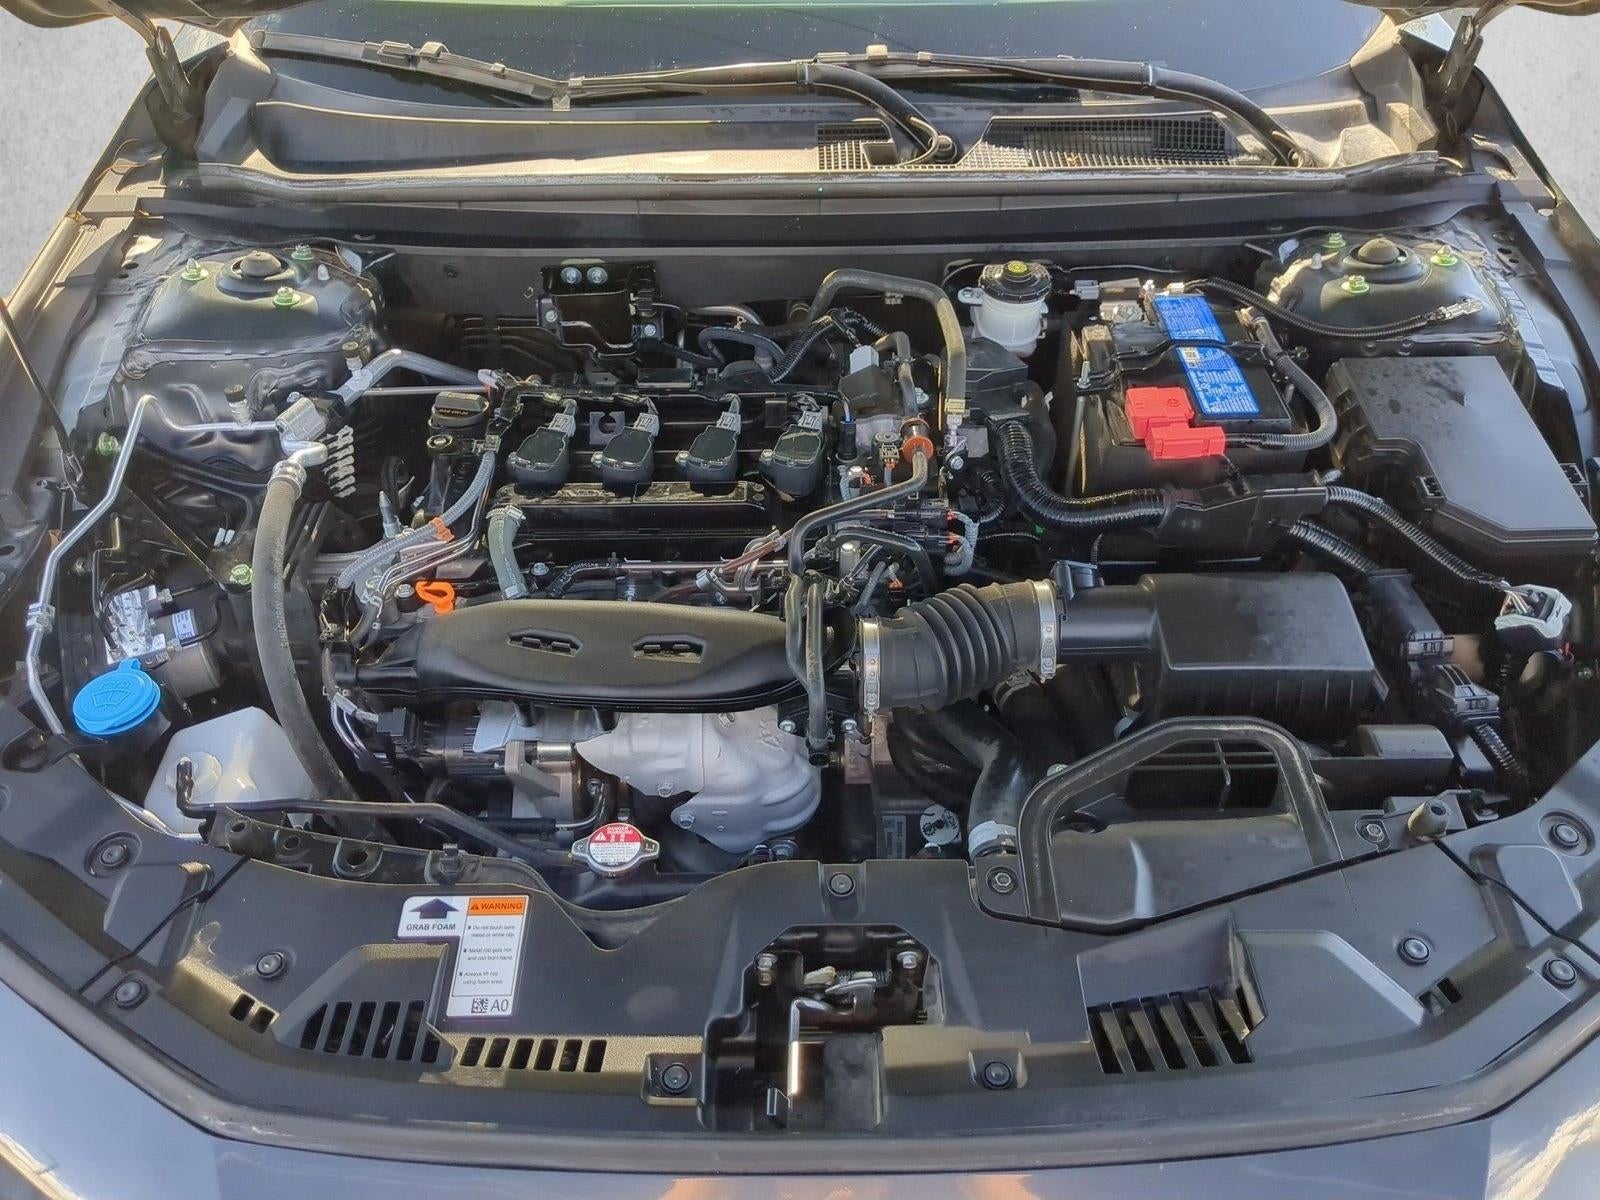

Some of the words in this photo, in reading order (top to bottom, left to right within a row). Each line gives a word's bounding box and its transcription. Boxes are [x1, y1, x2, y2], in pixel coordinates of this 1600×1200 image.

[480, 902, 523, 910] WARNING
[406, 923, 430, 931] GRAB
[431, 923, 456, 931] FOAM
[490, 998, 509, 1012] A0
